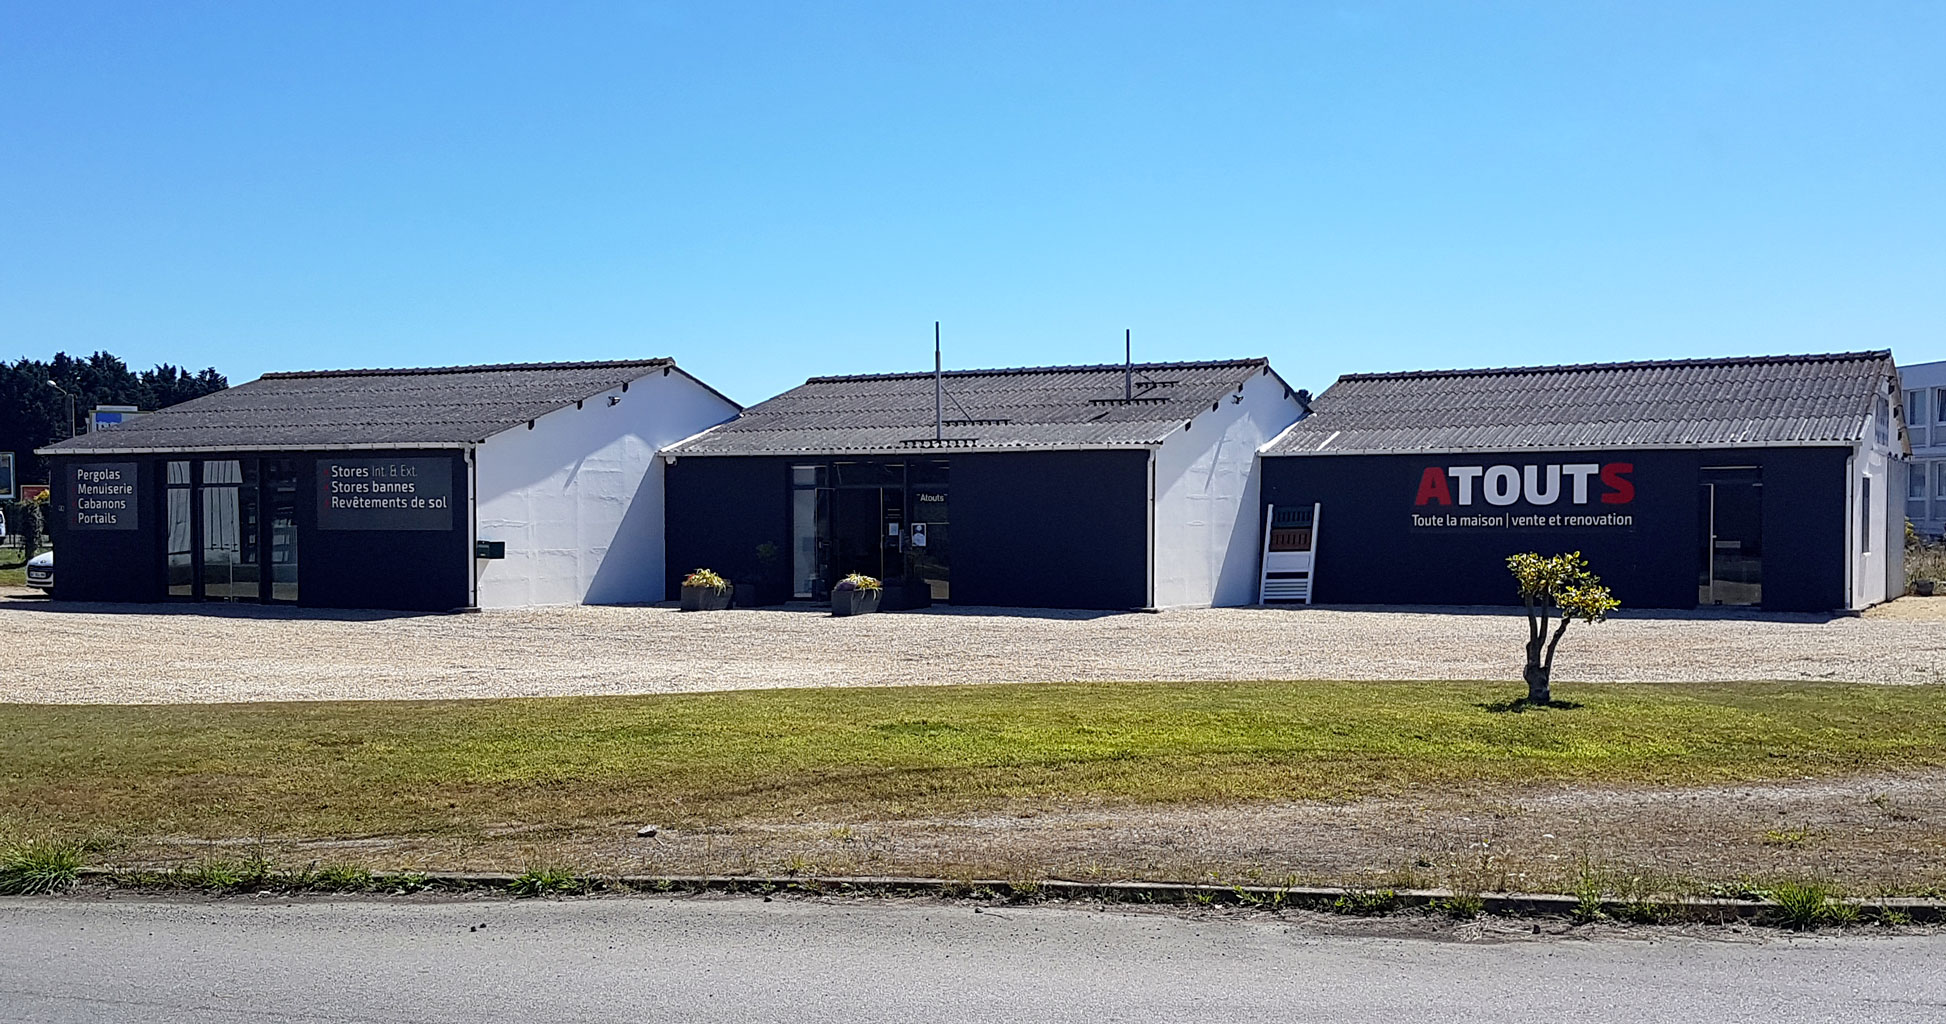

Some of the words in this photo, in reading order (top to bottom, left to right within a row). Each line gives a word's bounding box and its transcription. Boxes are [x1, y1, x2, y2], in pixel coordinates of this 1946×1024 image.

[77, 468, 121, 483] Pergolas
[331, 465, 369, 477] Stores
[372, 465, 386, 477] Int.
[389, 464, 398, 477] &
[400, 464, 418, 477] Ext.
[78, 483, 133, 494] Menuiserie
[331, 481, 369, 493] Stores
[372, 480, 415, 493] bannes
[1415, 462, 1635, 506] ATOUTS
[78, 498, 126, 509] Cabanons
[331, 496, 408, 508] Revêtements
[410, 496, 425, 508] de
[428, 496, 447, 508] sol
[78, 512, 117, 524] Portails
[1412, 514, 1444, 527] Toute
[1446, 514, 1457, 527] la
[1460, 514, 1503, 527] maison
[1511, 513, 1546, 527] vente
[1549, 513, 1562, 526] et
[1564, 512, 1633, 526] renovation
